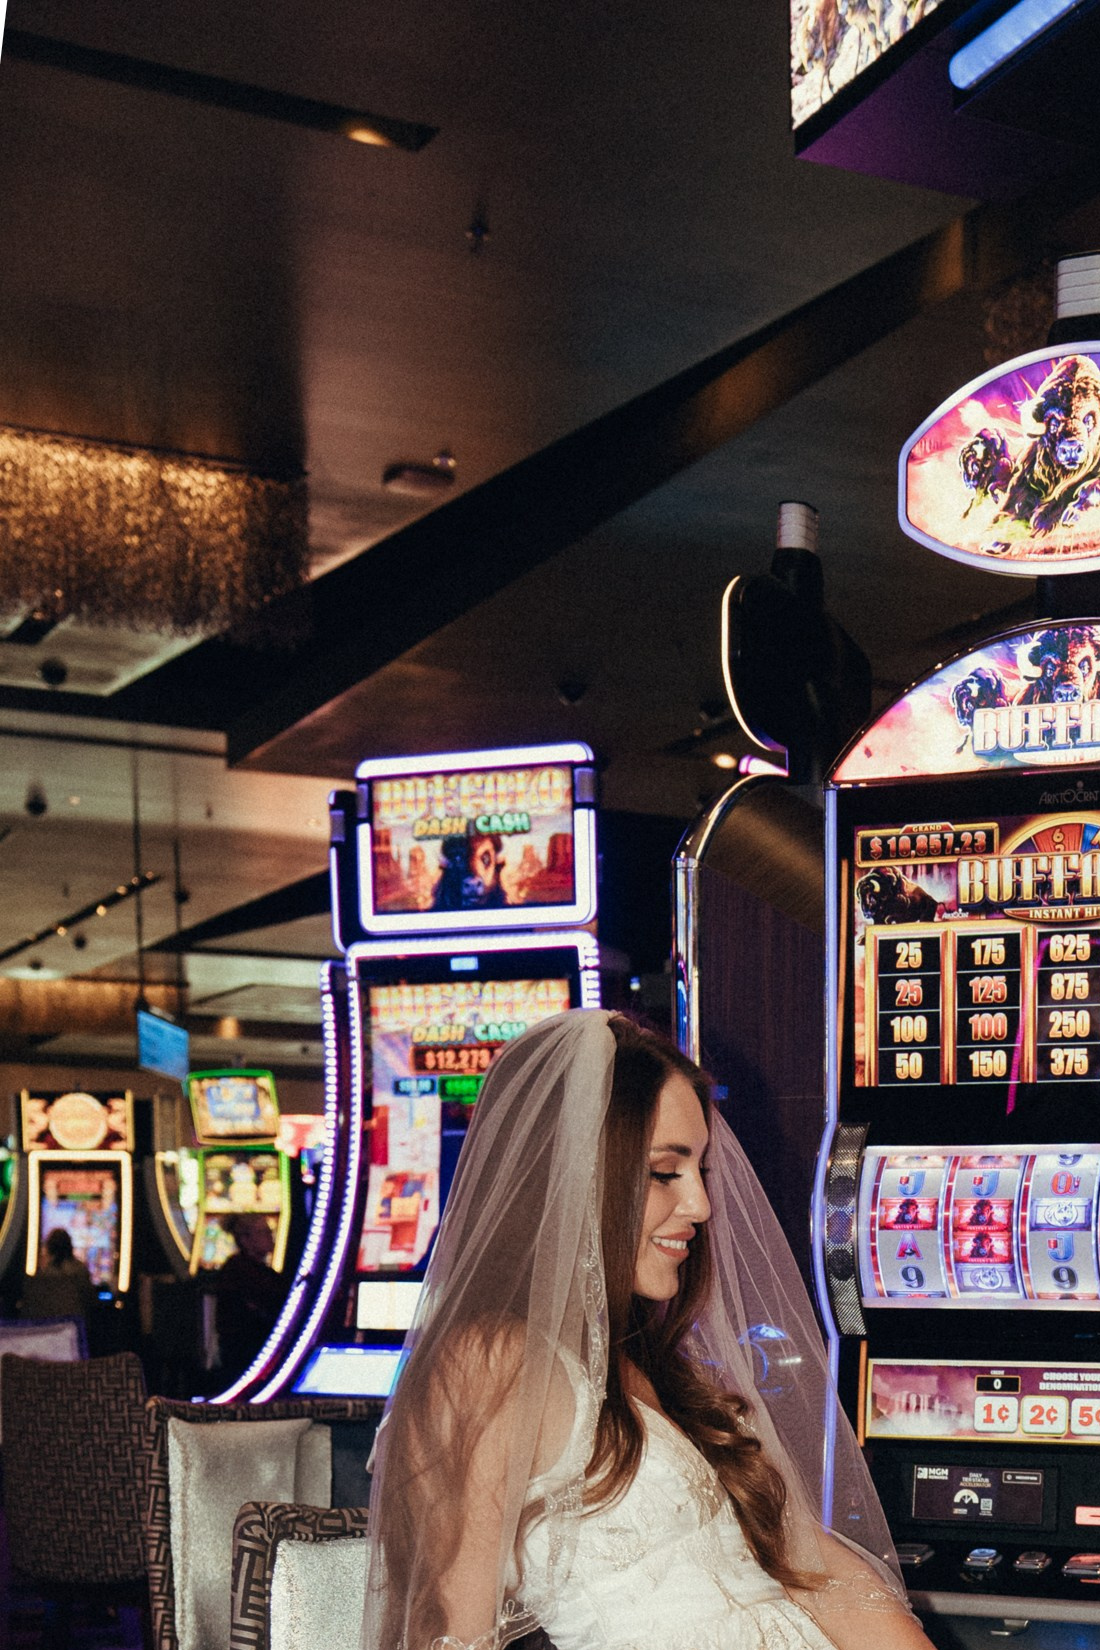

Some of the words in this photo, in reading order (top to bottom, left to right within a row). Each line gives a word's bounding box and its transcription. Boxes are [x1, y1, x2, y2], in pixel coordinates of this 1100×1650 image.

[413, 816, 468, 840] DASH
[475, 812, 531, 835] CASH
[869, 836, 883, 860] $
[887, 830, 986, 859] 10,857.23
[1029, 906, 1081, 919] INSTANT
[896, 941, 922, 969] 25
[971, 938, 1005, 965] 175
[1049, 934, 1090, 962] 625
[895, 979, 923, 1006] 25
[969, 975, 1007, 1004] 125
[1051, 972, 1089, 1000] 875
[890, 1015, 927, 1043] 100
[969, 1012, 1007, 1041] 100
[1049, 1010, 1090, 1038] 250
[896, 1052, 923, 1079] 50
[969, 1050, 1007, 1077] 150
[1050, 1048, 1089, 1075] 375
[898, 1170, 926, 1197] J
[971, 1170, 1000, 1197] J
[1051, 1171, 1078, 1197] Q
[896, 1231, 923, 1260] A
[1048, 1232, 1075, 1263] J
[901, 1266, 925, 1289] 9
[1052, 1266, 1078, 1290] 9
[993, 1378, 1002, 1390] 0
[1043, 1371, 1078, 1381] CHOOSE
[983, 1403, 1009, 1424] 1¢
[1029, 1404, 1058, 1425] 2¢
[929, 1467, 948, 1476] MGM
